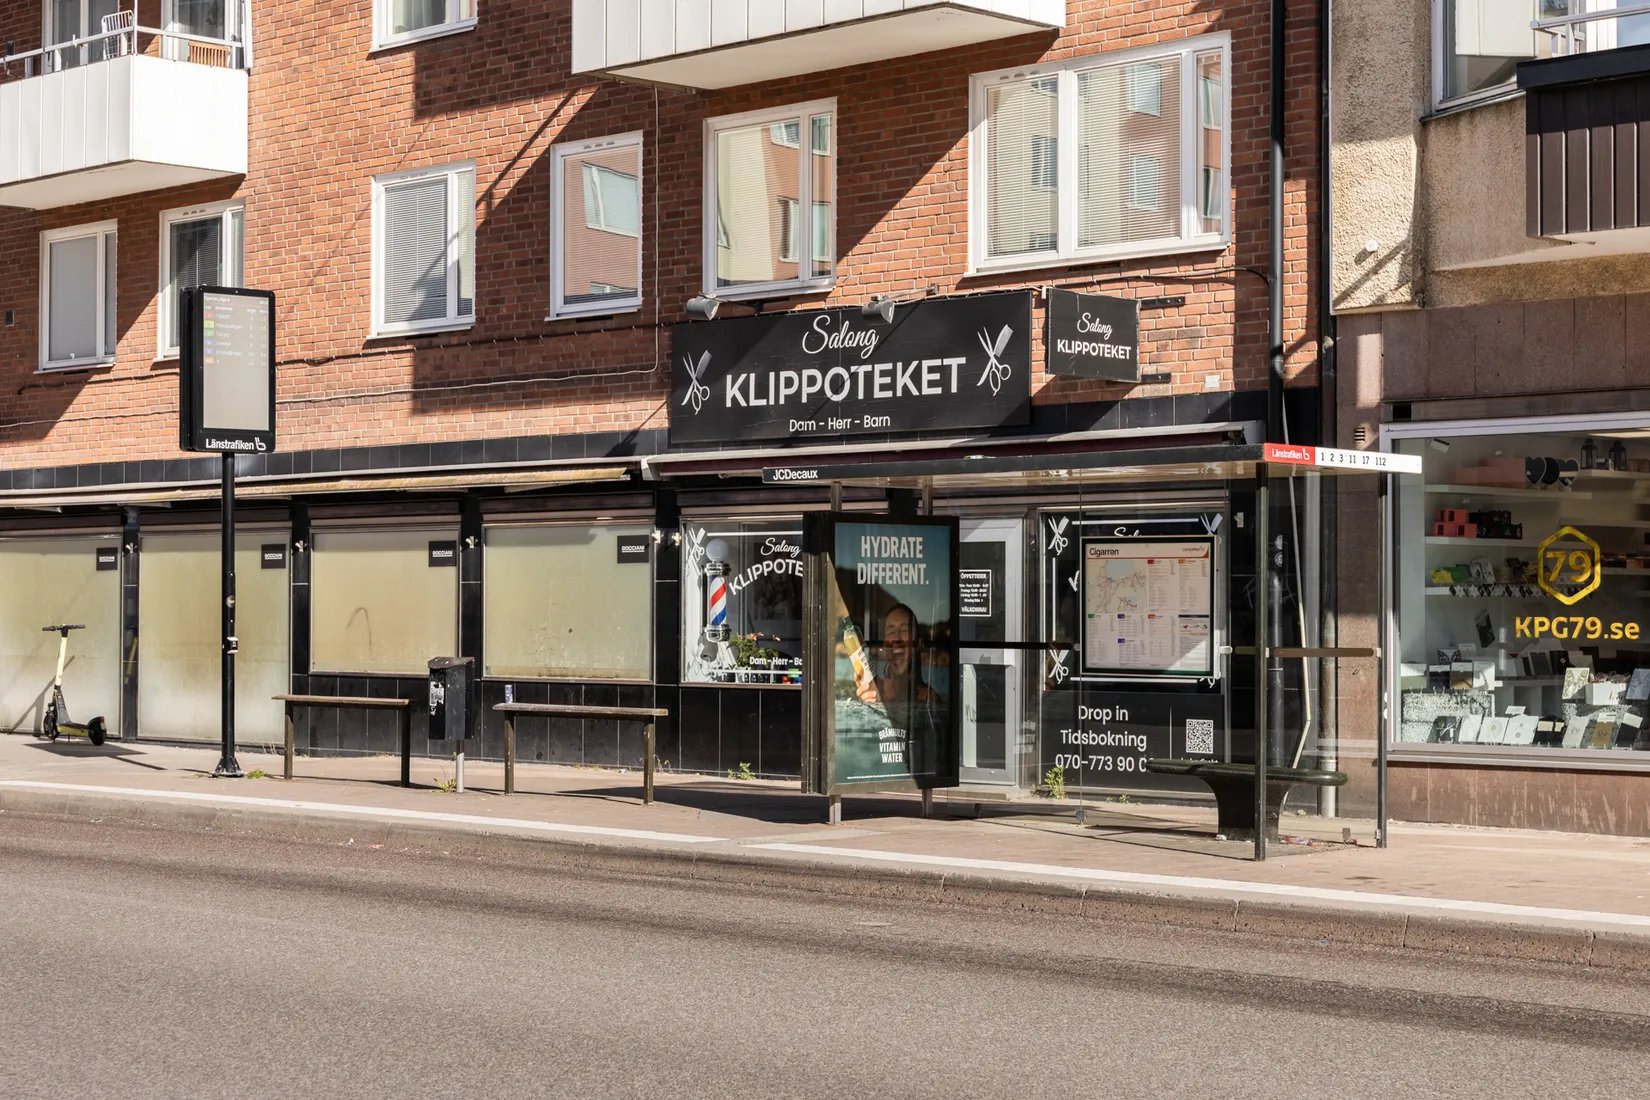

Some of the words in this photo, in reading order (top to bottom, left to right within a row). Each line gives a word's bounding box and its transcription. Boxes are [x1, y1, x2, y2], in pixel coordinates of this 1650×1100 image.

[1076, 312, 1112, 340] Salong
[802, 314, 879, 359] Salong
[1057, 339, 1132, 360] KLIPPOTEKET
[726, 356, 966, 408] KLIPPOTEKET
[789, 419, 816, 432] Dam
[828, 417, 852, 430] Herr
[864, 414, 890, 428] Barn
[206, 438, 254, 450] Länstrafiken
[1272, 448, 1302, 460] Länstrafiken
[1321, 452, 1325, 461] 1
[1330, 453, 1334, 462] 2
[1339, 454, 1344, 462] 3
[1350, 454, 1356, 464] 11
[1362, 456, 1370, 465] 17
[1376, 456, 1386, 466] 112
[773, 469, 818, 480] JCDecaux
[760, 538, 801, 558] Salong
[861, 536, 923, 558] HYDRATE
[1089, 548, 1119, 558] Cigarren
[858, 562, 929, 584] DIFFERENT.
[1546, 551, 1592, 582] 79
[1516, 616, 1640, 640] KPG79.se
[750, 656, 766, 665] Dam
[772, 657, 788, 665] Herr
[1078, 706, 1112, 725] Drop
[1116, 706, 1128, 721] in
[879, 742, 905, 752] VITAMIN
[1060, 729, 1147, 752] Tidsbokning
[882, 753, 902, 763] WATER
[1055, 754, 1112, 772] 070-773
[1117, 757, 1134, 772] 90
